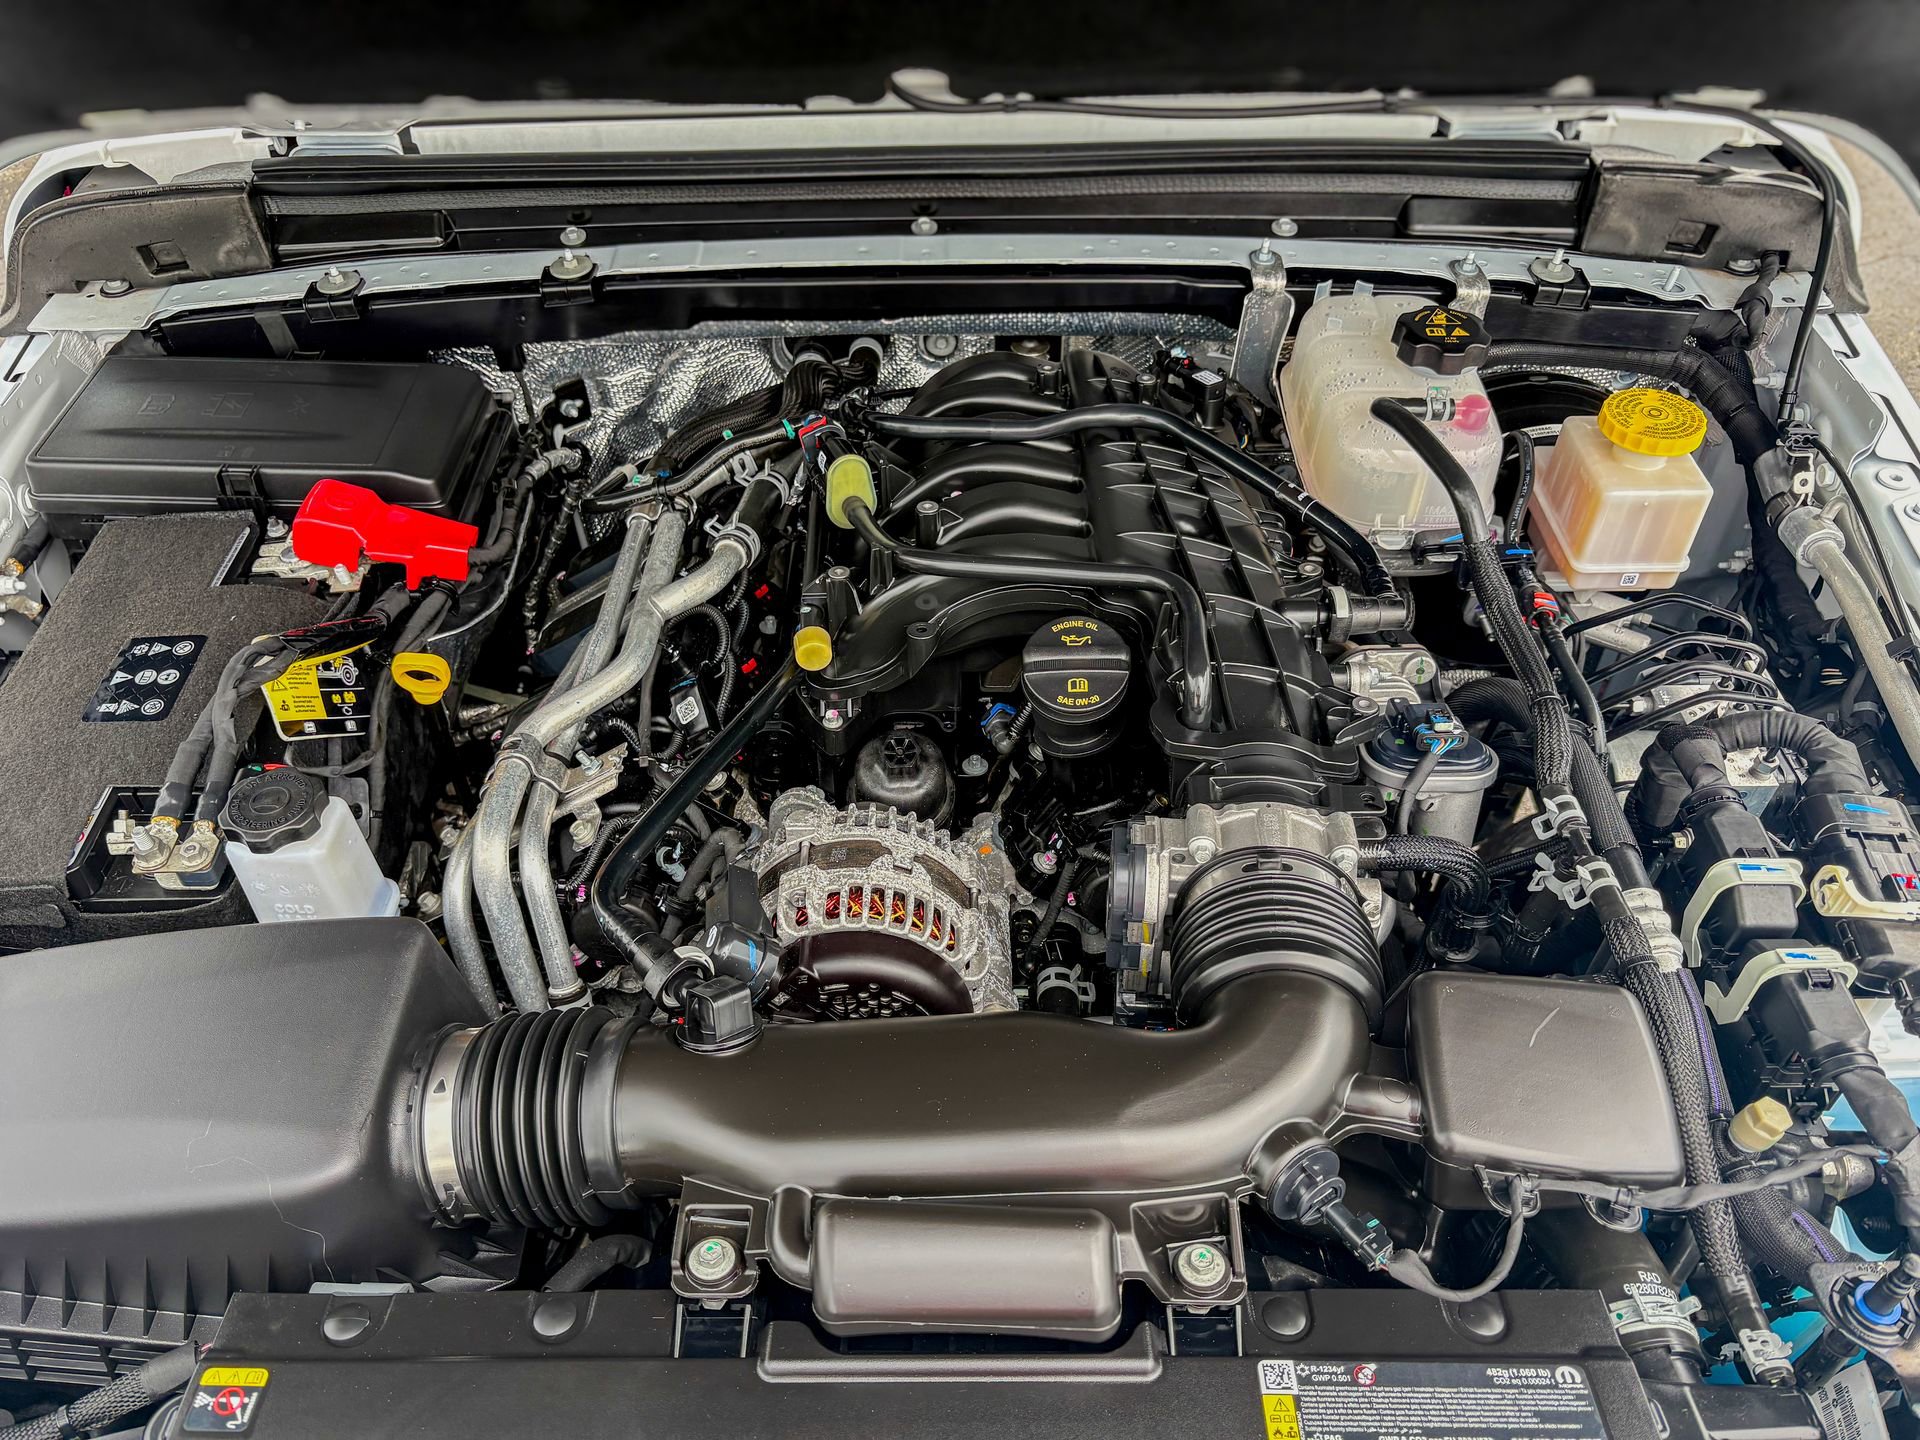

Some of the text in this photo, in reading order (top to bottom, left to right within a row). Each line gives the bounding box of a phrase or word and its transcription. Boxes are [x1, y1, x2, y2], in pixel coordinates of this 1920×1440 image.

[1051, 620, 1099, 633] ENGINE OIL
[1056, 694, 1100, 706] SAE 0W-20
[264, 772, 306, 790] APPROVED
[240, 815, 287, 829] STEERING
[274, 903, 315, 914] COLD
[1637, 1271, 1662, 1284] RAD
[1310, 1365, 1344, 1374] R-1234yf
[1486, 1367, 1509, 1378] 482g
[1537, 1368, 1551, 1378] lb)
[1311, 1374, 1331, 1382] GWP
[1493, 1377, 1511, 1385] CO2
